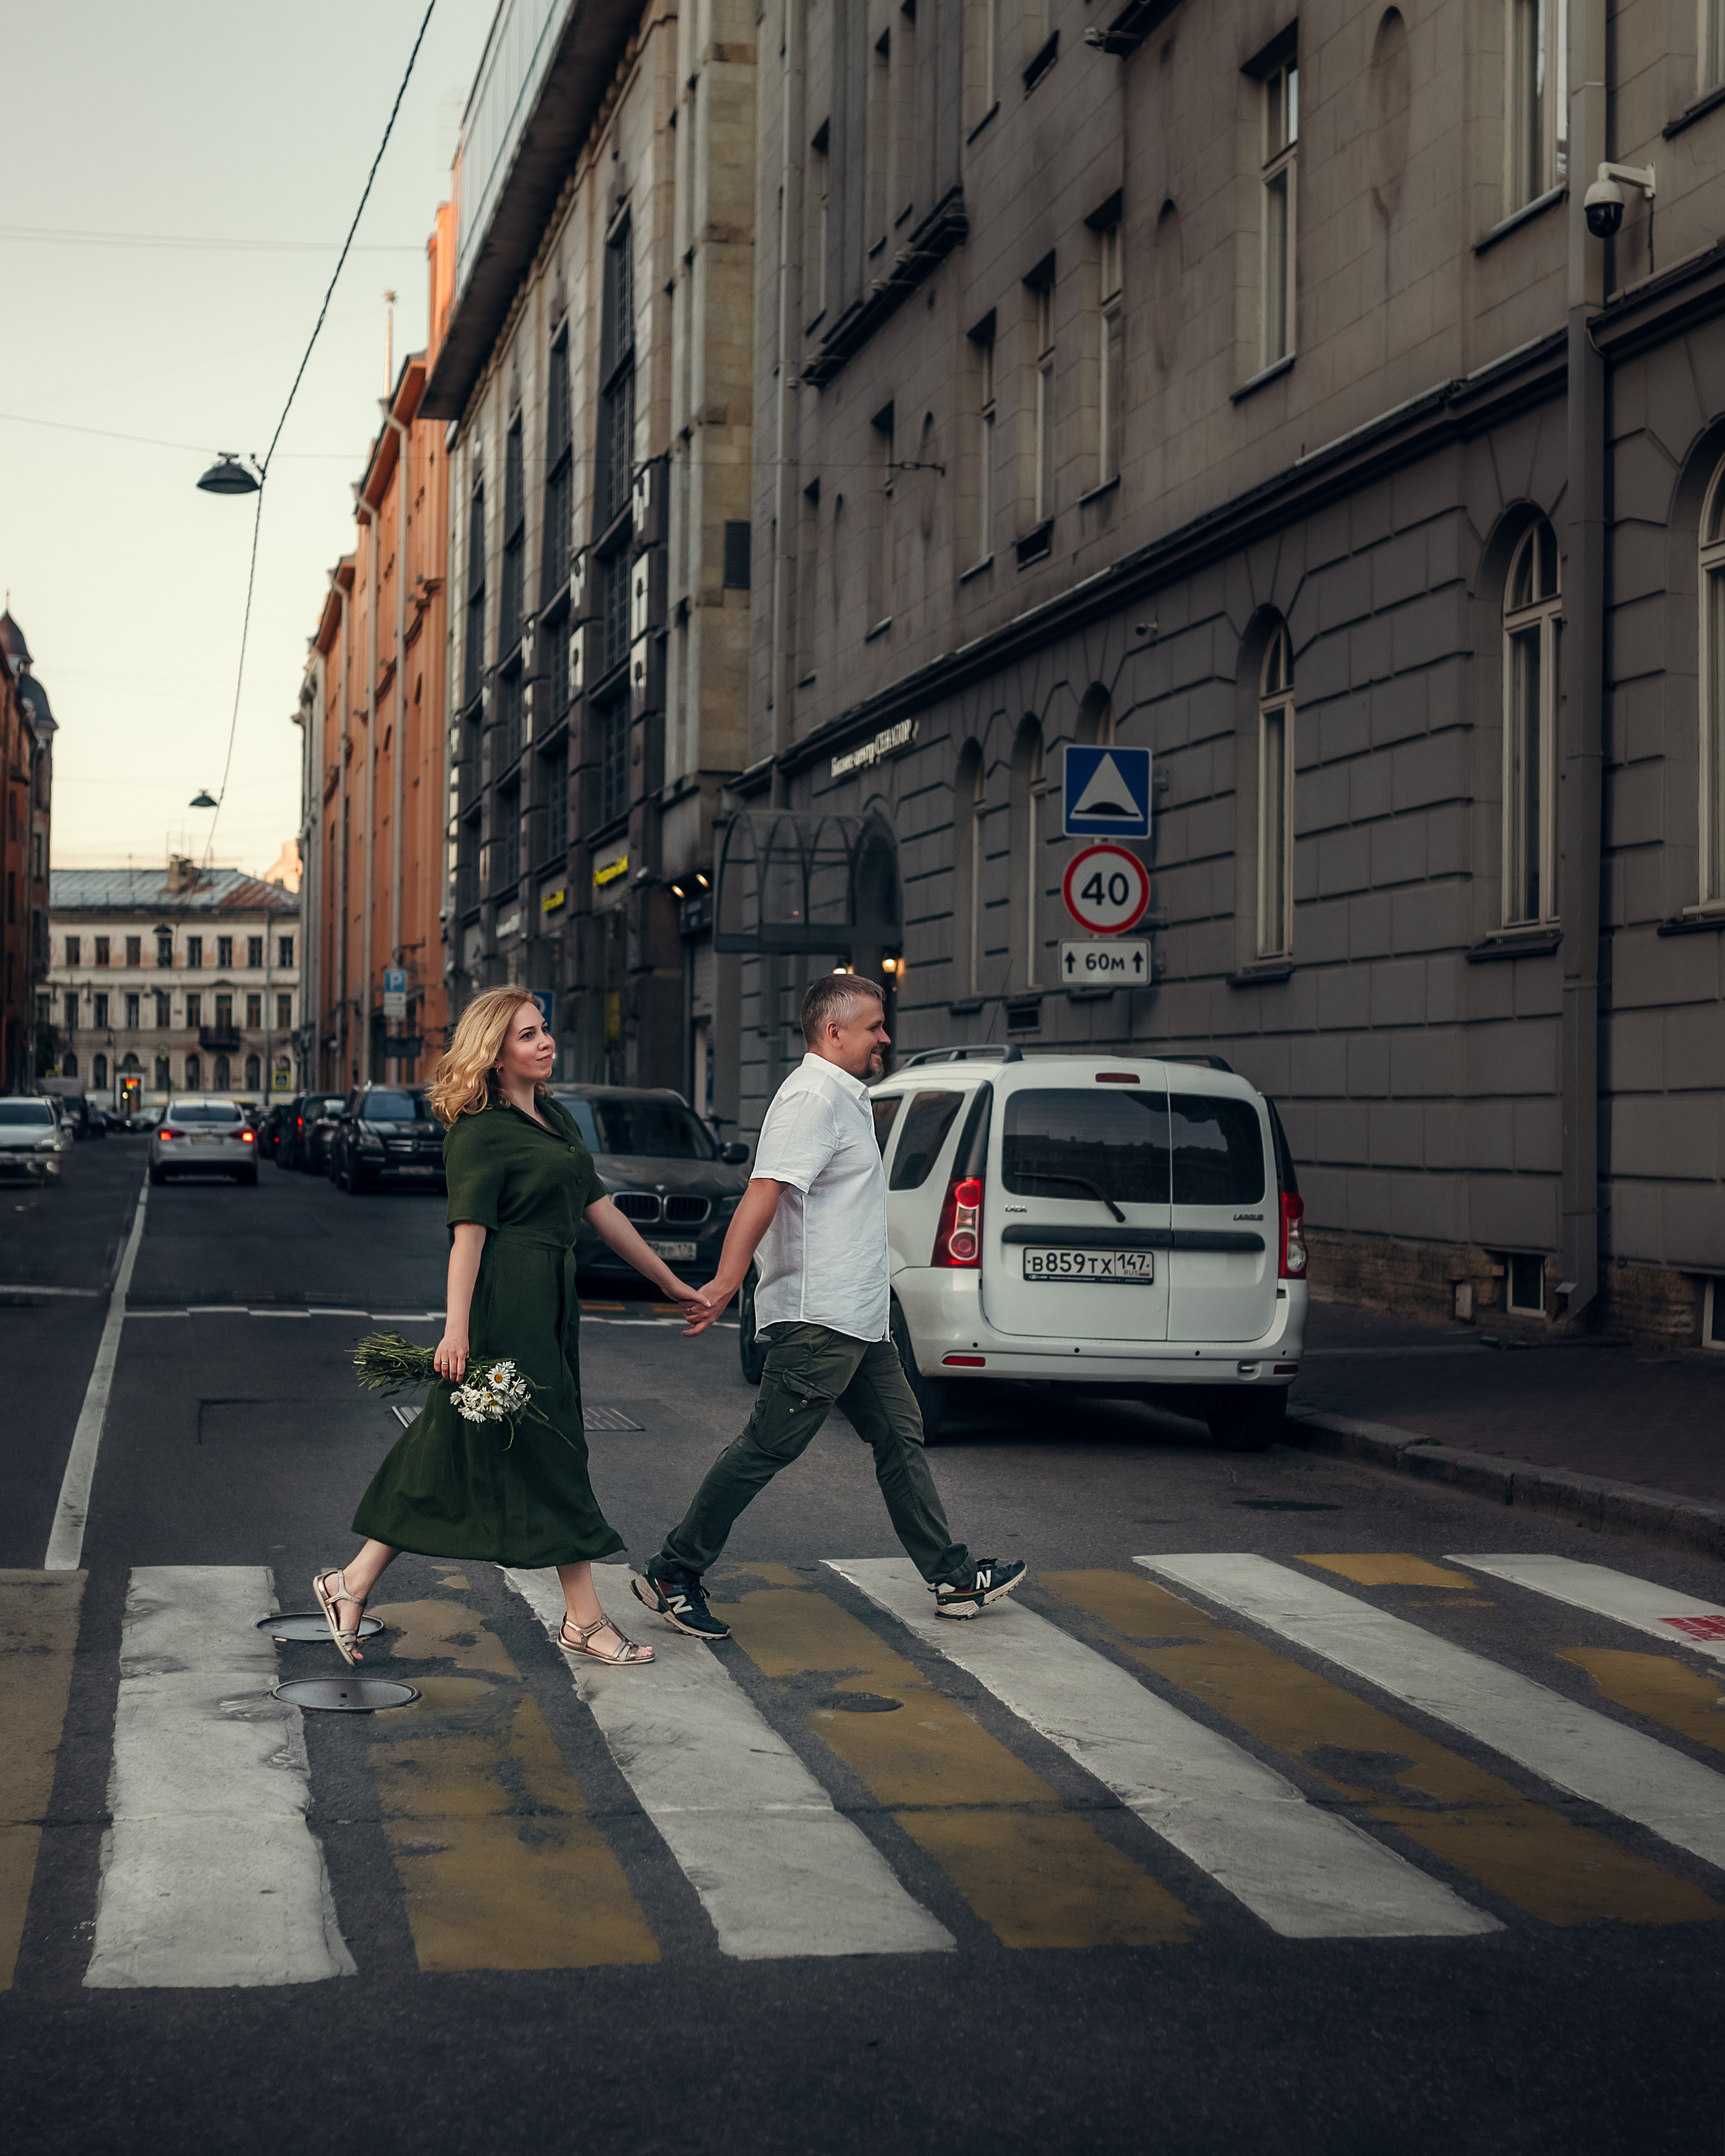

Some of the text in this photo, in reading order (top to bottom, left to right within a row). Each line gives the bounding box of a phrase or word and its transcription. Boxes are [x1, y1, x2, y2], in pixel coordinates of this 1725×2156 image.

[1081, 872, 1129, 906] 40
[1005, 1204, 1027, 1213] LADA
[1117, 1253, 1146, 1271] 147
[1123, 1269, 1139, 1277] RUS
[974, 1569, 992, 1590] N
[666, 1594, 693, 1615] N
